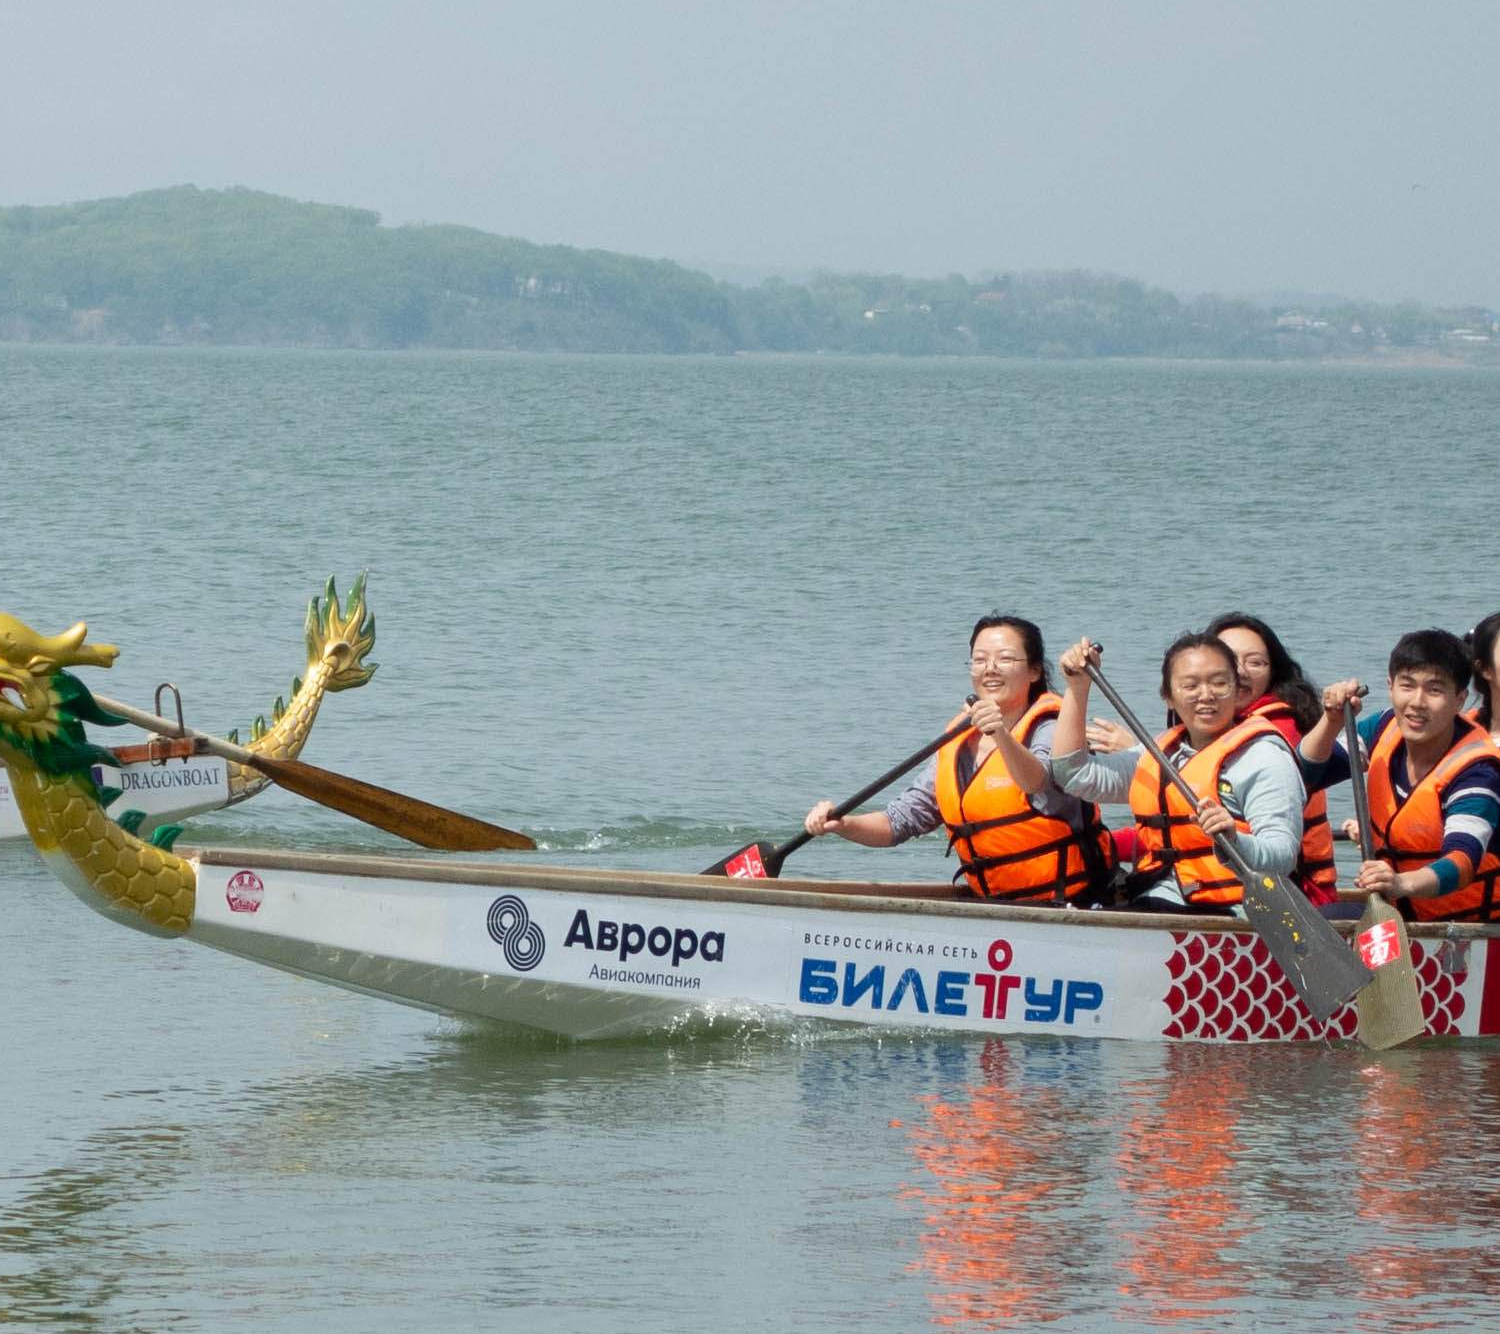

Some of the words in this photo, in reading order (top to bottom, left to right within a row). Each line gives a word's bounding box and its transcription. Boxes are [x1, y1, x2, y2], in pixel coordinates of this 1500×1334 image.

[120, 768, 220, 790] DRAGONBOAT
[563, 909, 726, 967] Аврора
[804, 933, 935, 956] ВСЕРОССИЙСКАЯ
[942, 946, 979, 960] СЕТЬ
[588, 964, 701, 989] Авиакомпания
